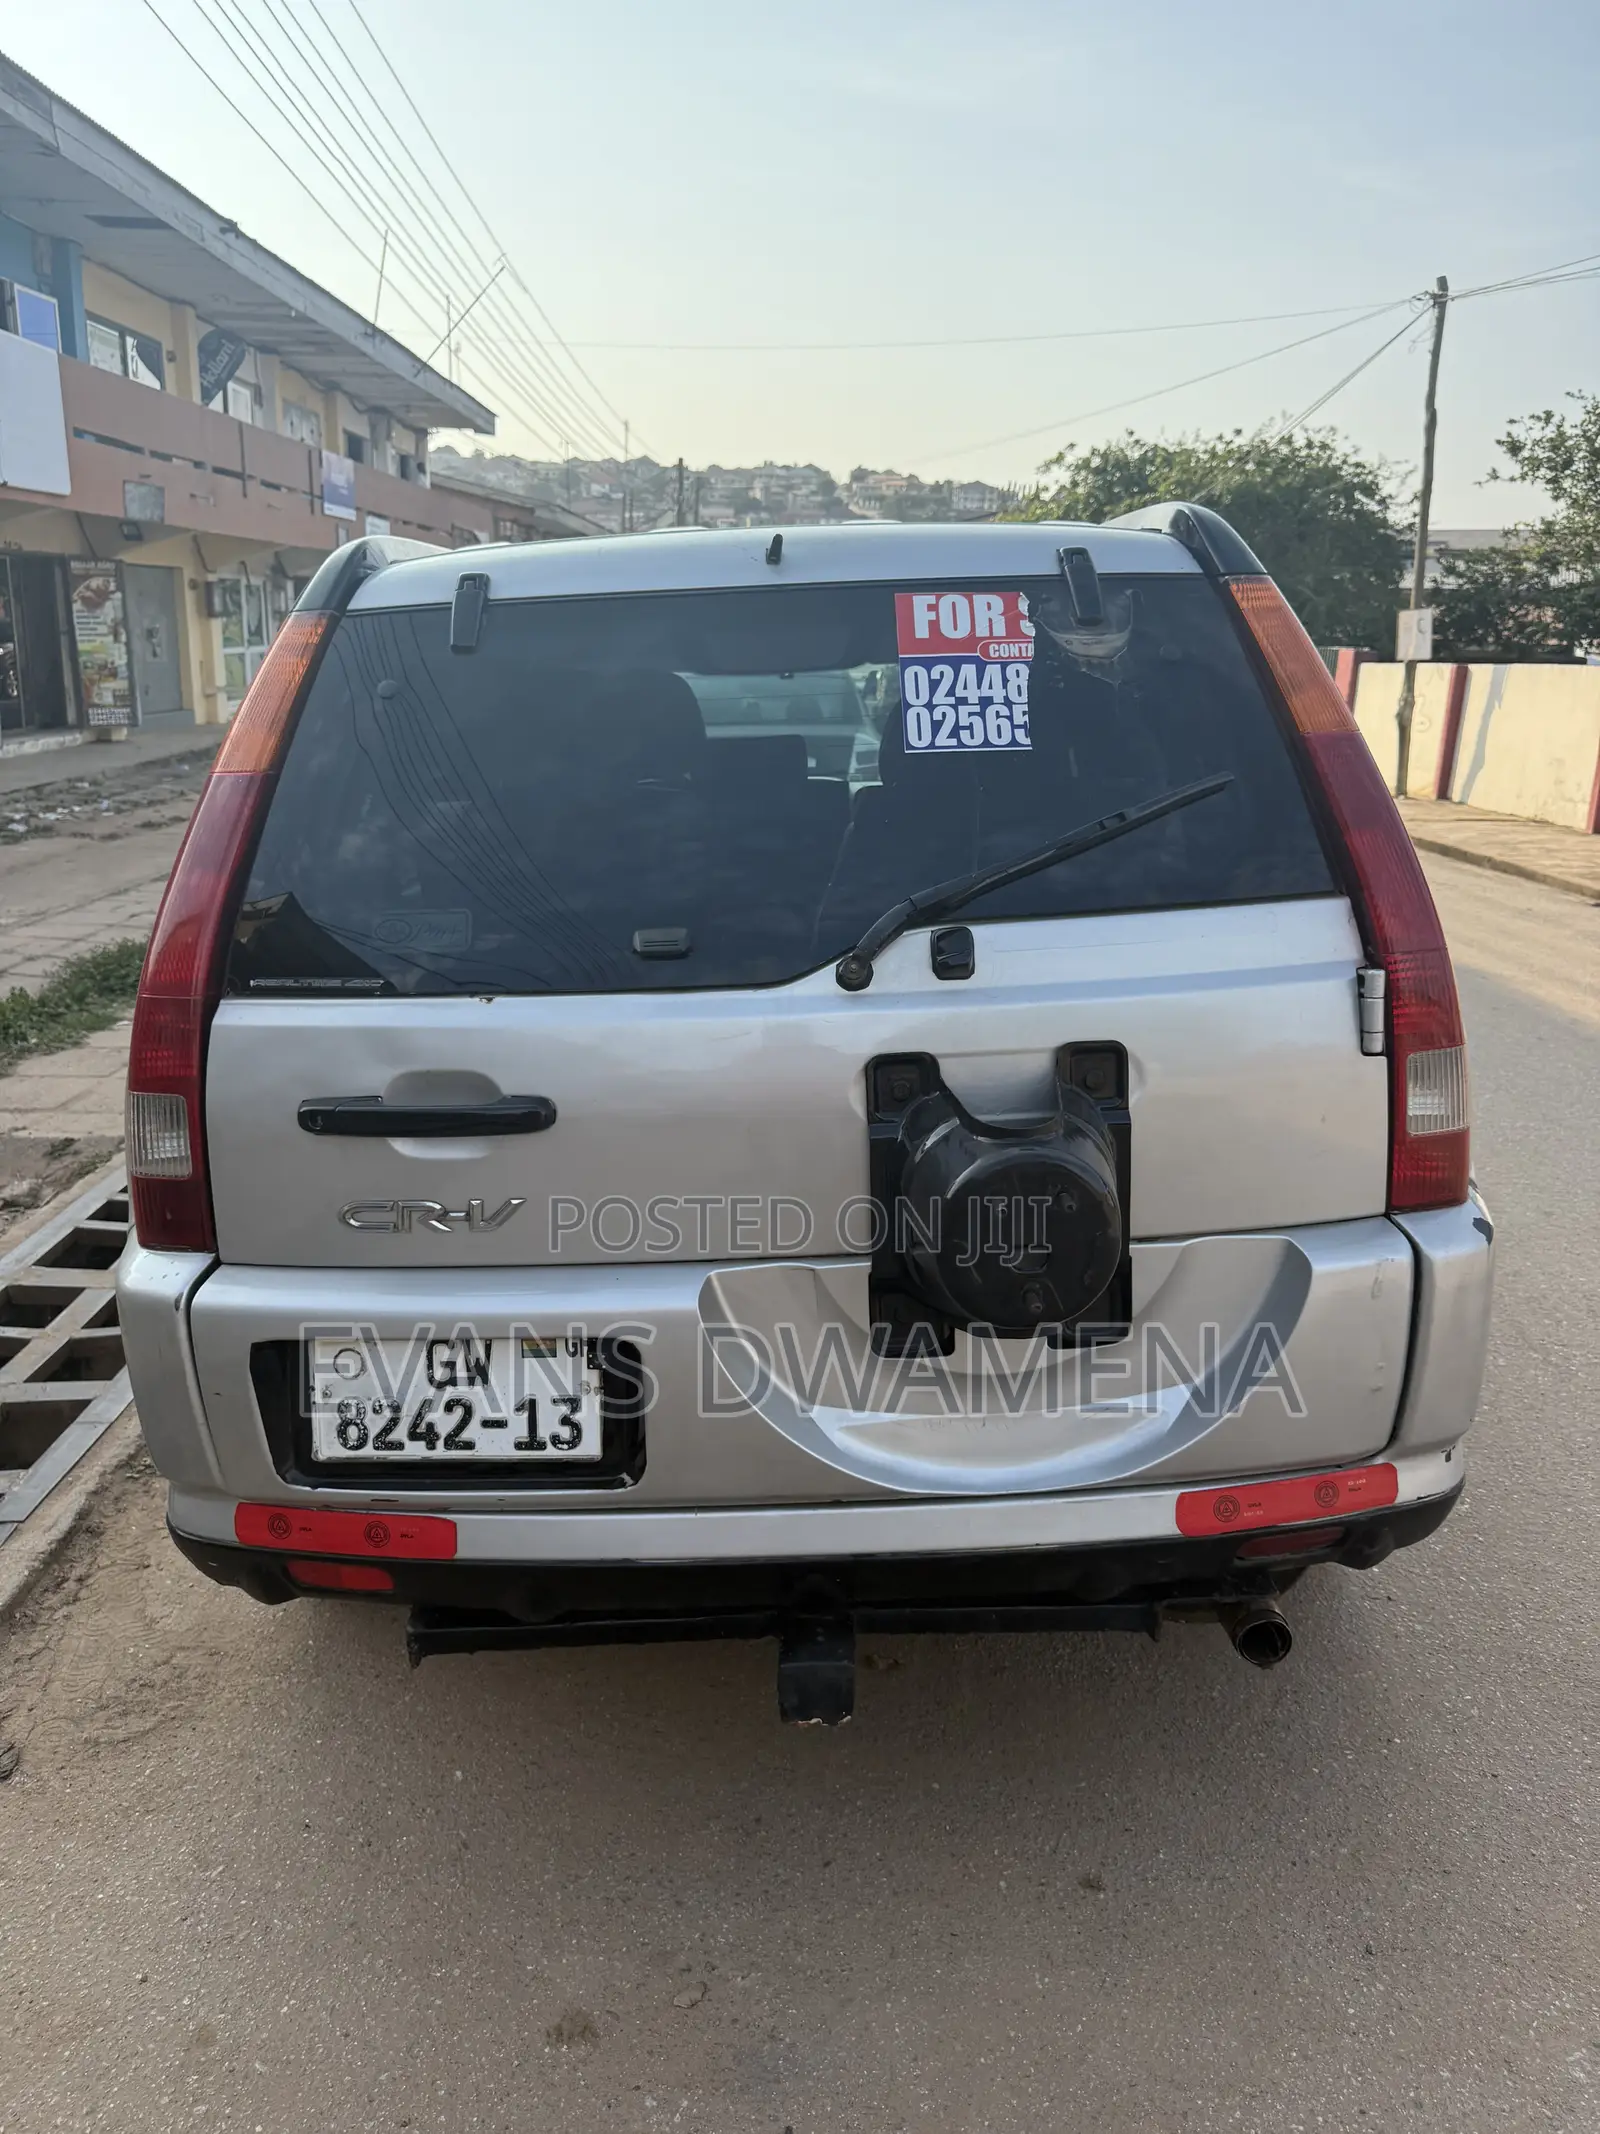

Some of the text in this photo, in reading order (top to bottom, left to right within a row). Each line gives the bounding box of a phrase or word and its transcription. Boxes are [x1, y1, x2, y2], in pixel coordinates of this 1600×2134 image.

[912, 594, 1006, 639] FOR
[904, 663, 1030, 706] 02448
[906, 704, 1032, 748] 02565
[338, 1197, 527, 1234] CR-V
[425, 1339, 492, 1389] GW
[336, 1395, 584, 1452] 8242-13
